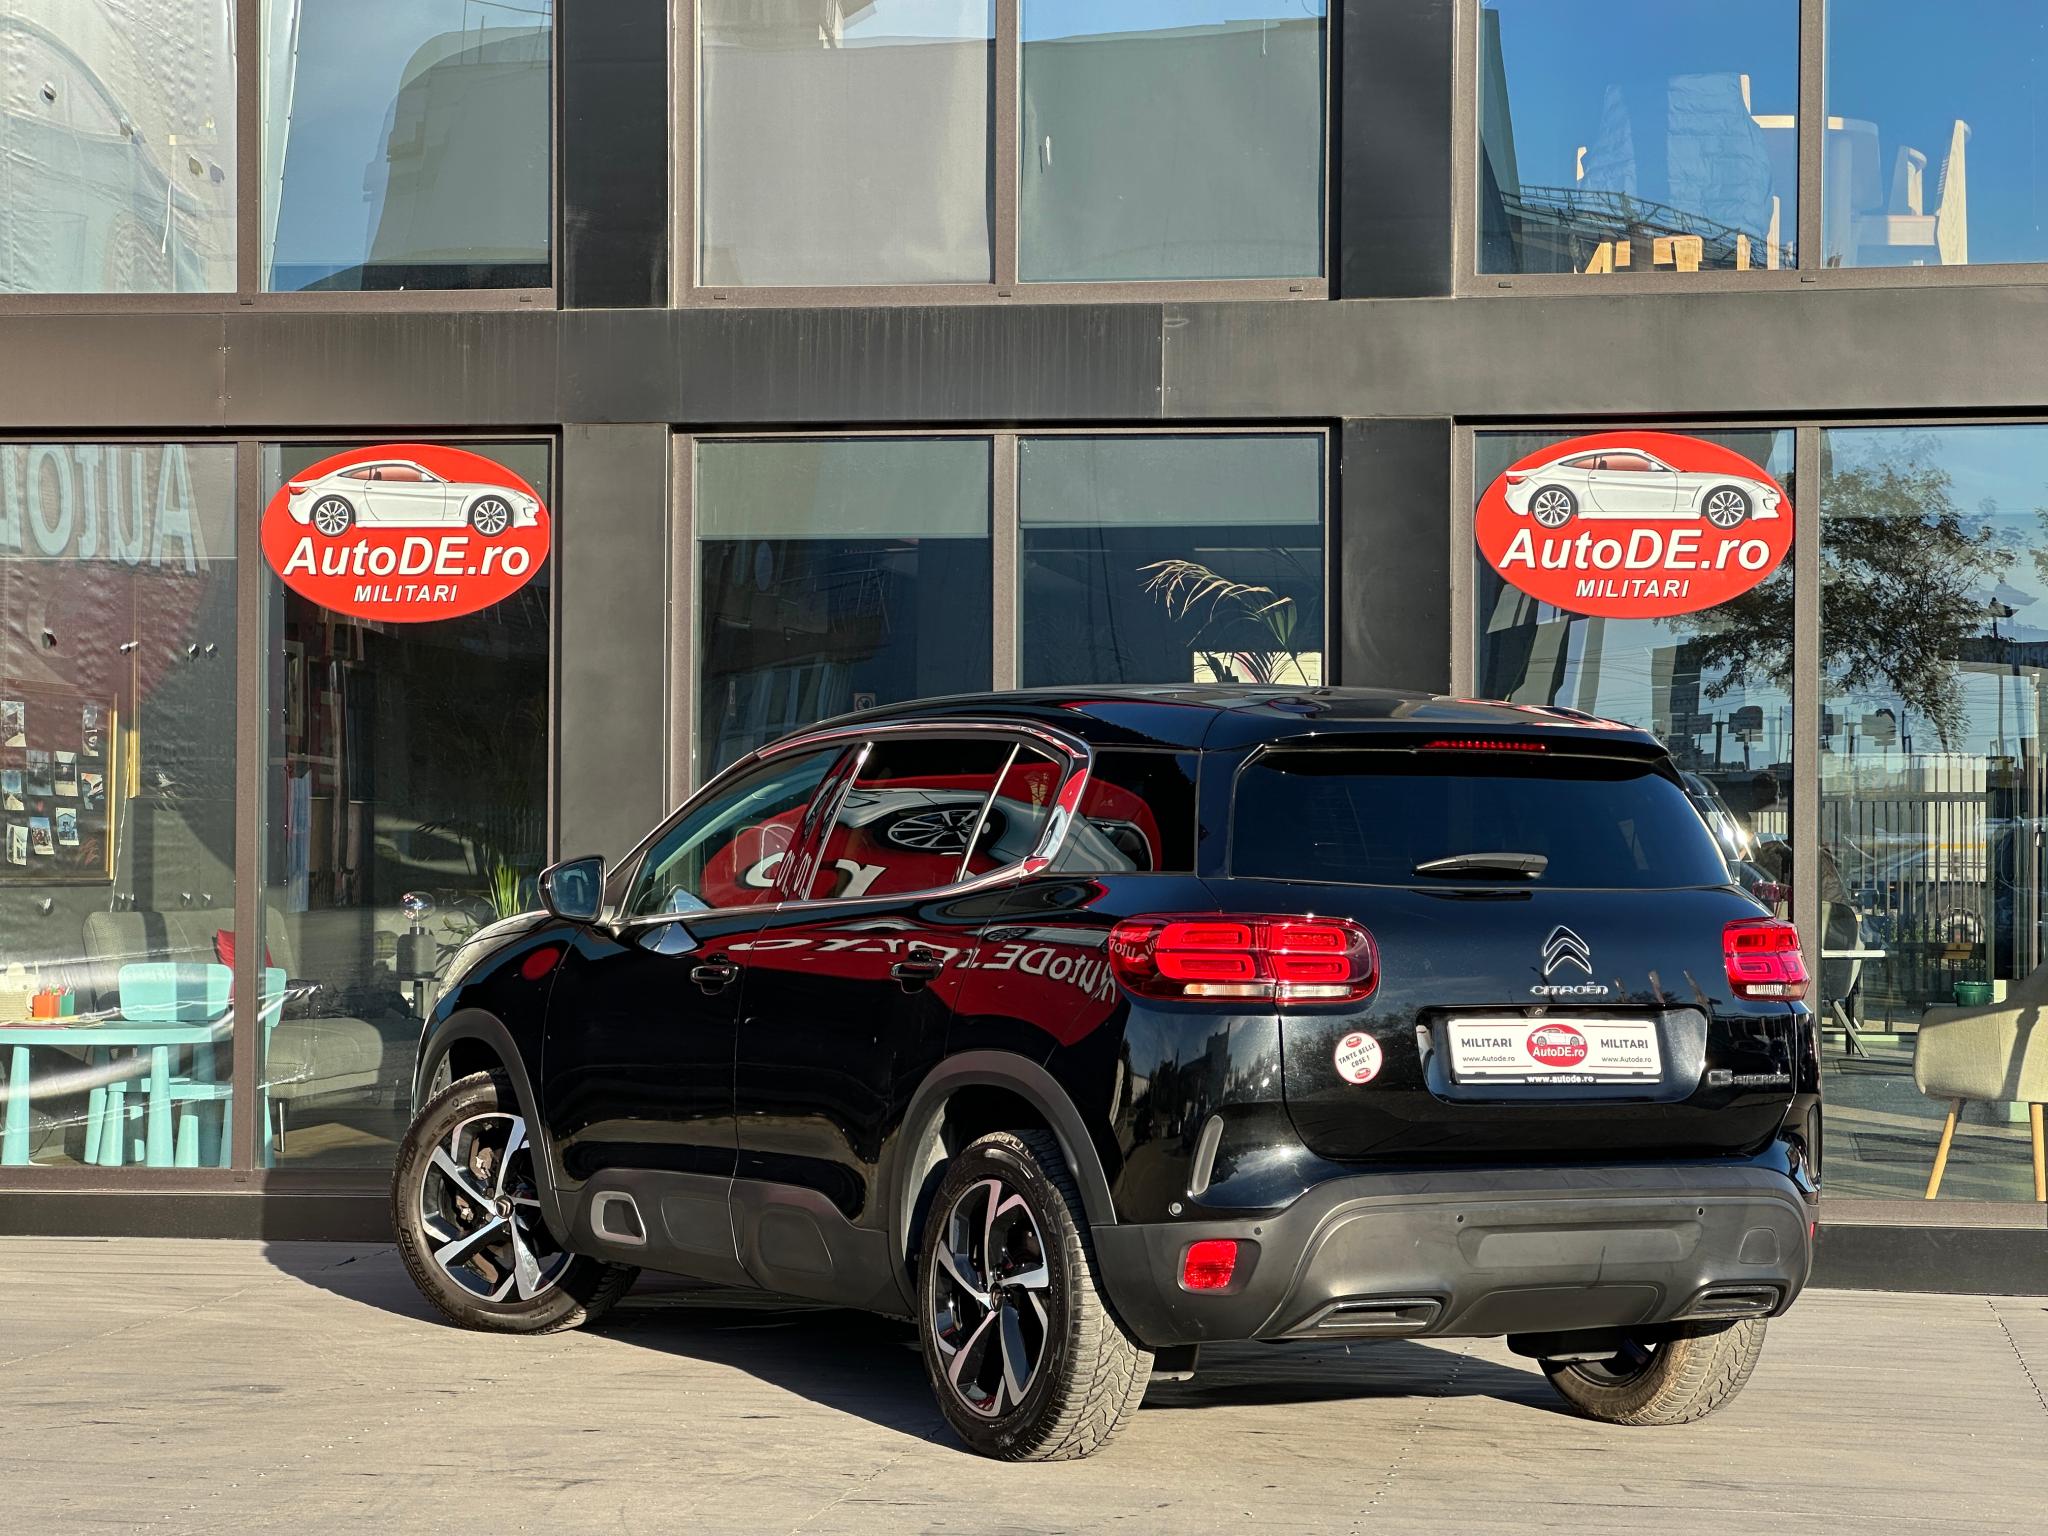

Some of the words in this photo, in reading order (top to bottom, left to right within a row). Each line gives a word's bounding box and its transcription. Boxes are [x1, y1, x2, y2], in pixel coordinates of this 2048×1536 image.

[1499, 528, 1771, 571] AutoDE.ro
[282, 536, 531, 577] AutoDE.ro
[353, 584, 458, 603] MILITARI
[1576, 579, 1689, 599] MILITARI
[1359, 1042, 1376, 1055] BELLE
[1461, 1038, 1512, 1048] MILITARI
[1601, 1038, 1648, 1049] MILITARI
[1532, 1046, 1585, 1058] AutoDE.ro
[1526, 1074, 1594, 1083] www.autode.ro
